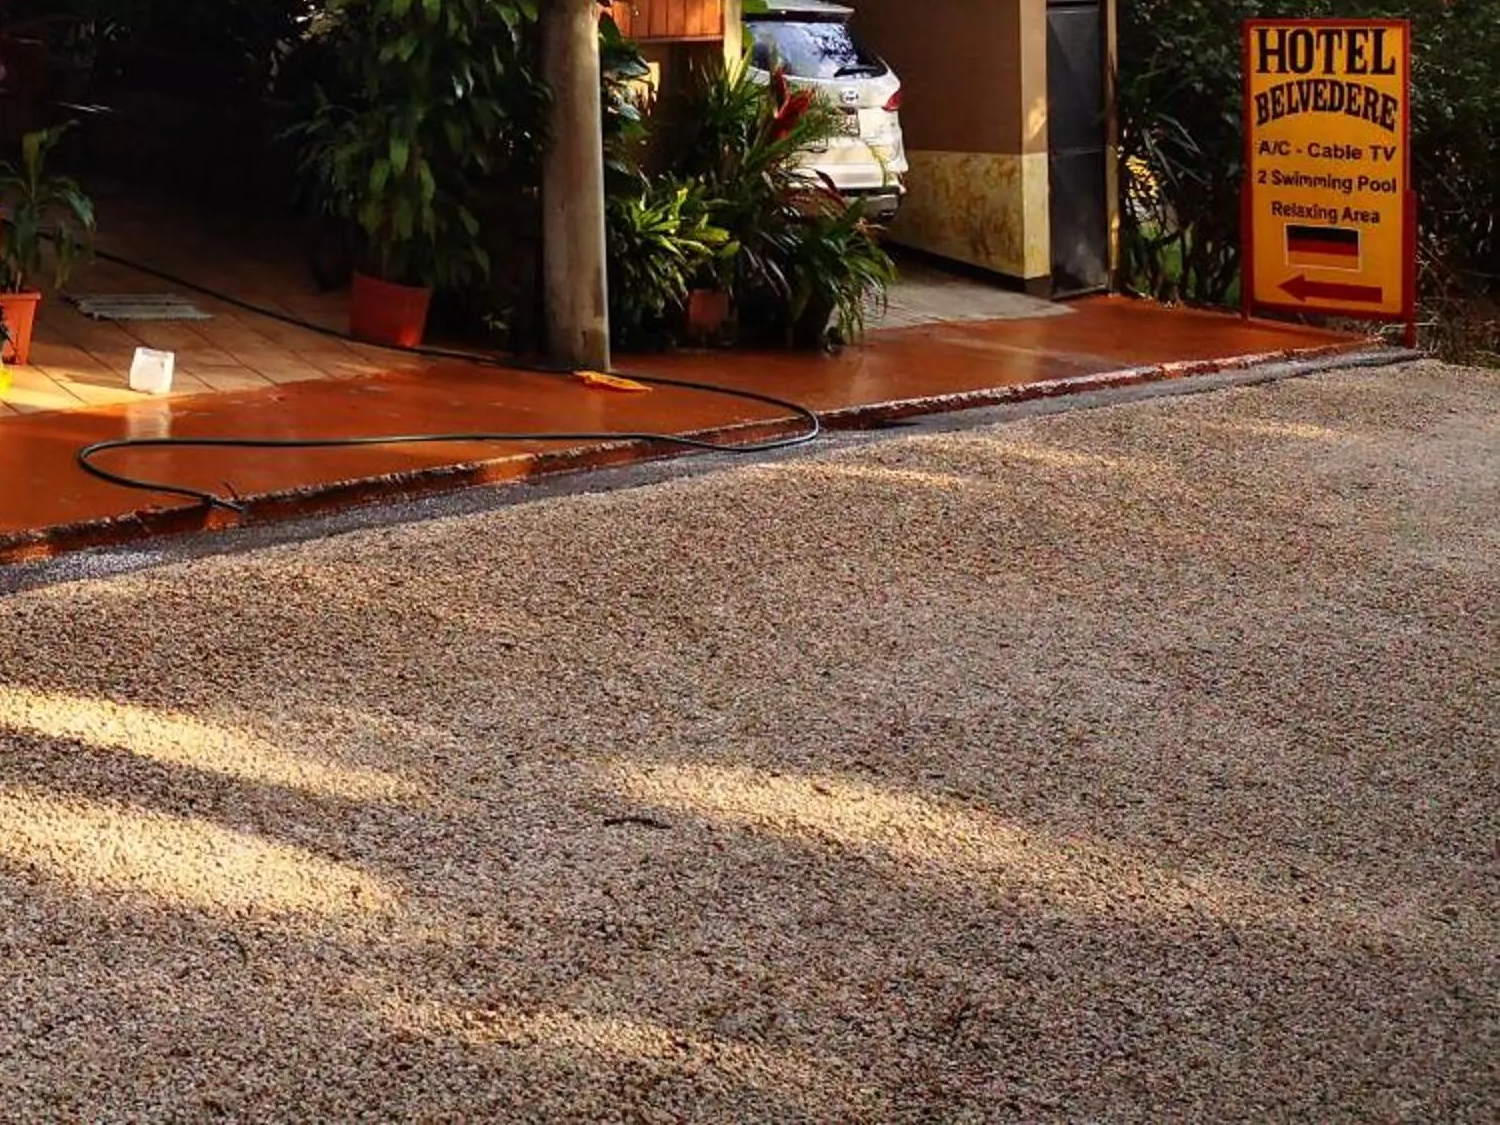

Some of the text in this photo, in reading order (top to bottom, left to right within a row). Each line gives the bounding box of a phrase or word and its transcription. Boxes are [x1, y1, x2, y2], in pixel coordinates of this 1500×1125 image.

[1256, 28, 1396, 75] HOTEL
[1254, 78, 1398, 133] BELVEDERE
[1258, 140, 1291, 156] A/C
[1307, 142, 1363, 160] Cable
[1369, 145, 1397, 161] TV
[1257, 169, 1397, 193] 2 Swimming Pool
[1271, 201, 1381, 224] Relaxing Area
